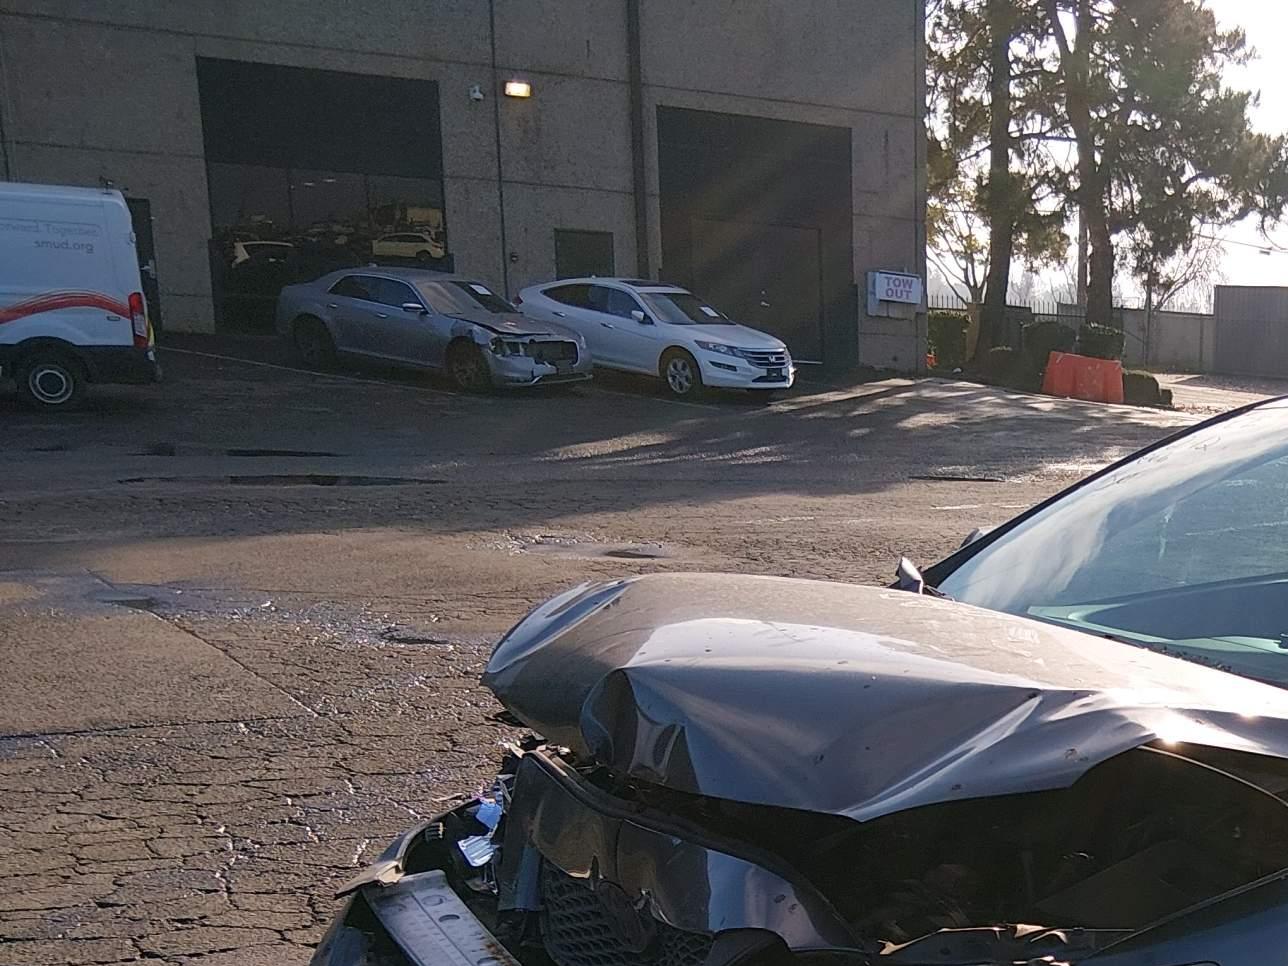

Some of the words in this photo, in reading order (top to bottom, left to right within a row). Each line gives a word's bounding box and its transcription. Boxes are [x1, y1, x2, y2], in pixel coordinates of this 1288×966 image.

[33, 239, 94, 254] smud.org
[883, 276, 914, 290] TOW
[884, 287, 913, 301] OUT
